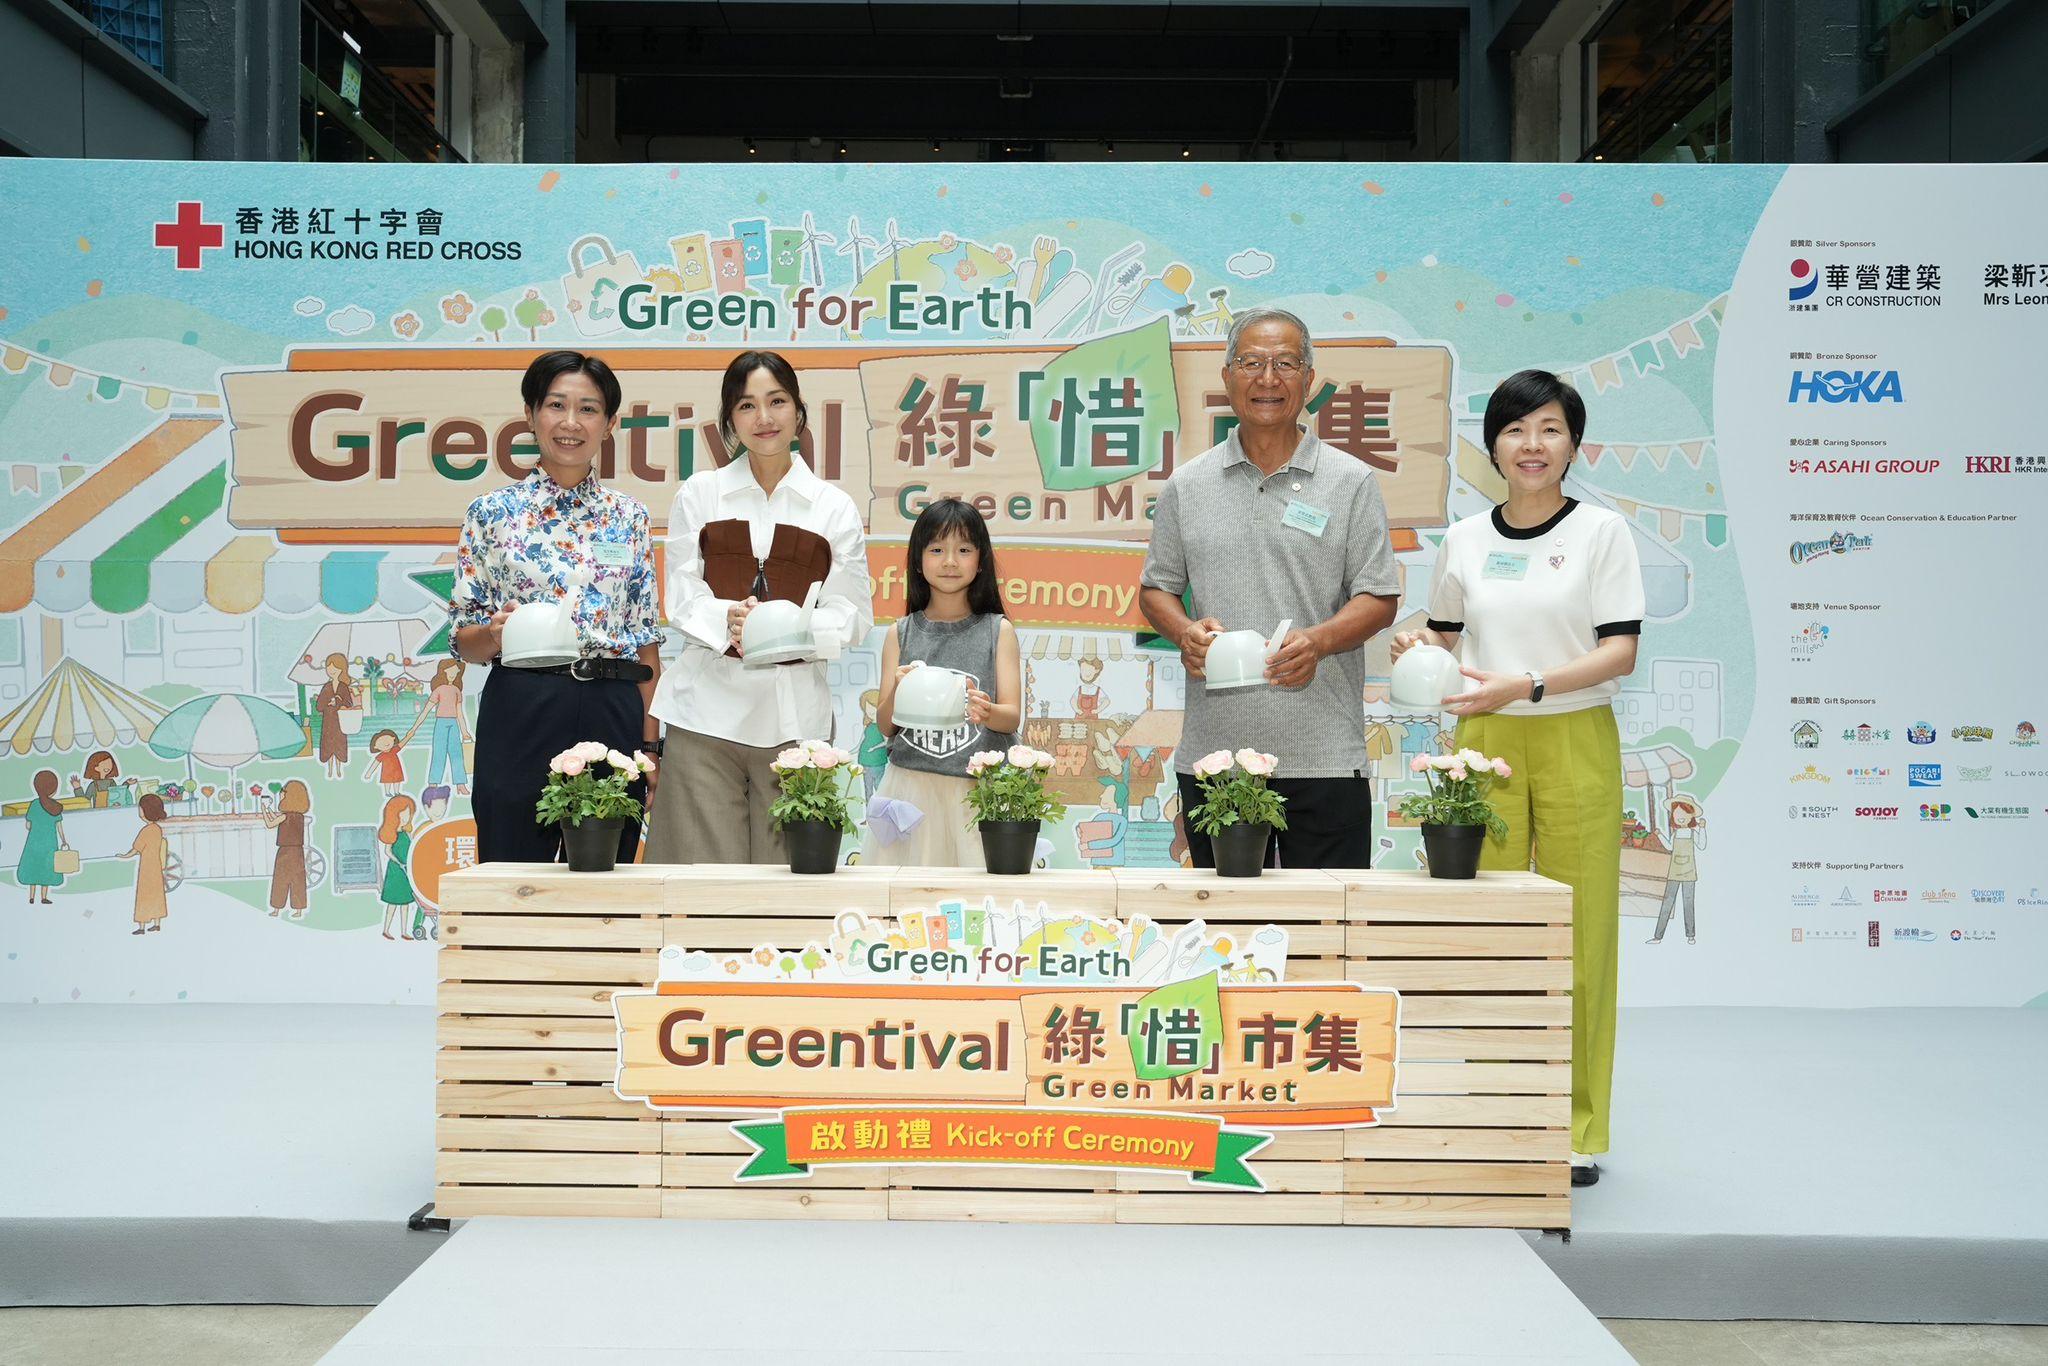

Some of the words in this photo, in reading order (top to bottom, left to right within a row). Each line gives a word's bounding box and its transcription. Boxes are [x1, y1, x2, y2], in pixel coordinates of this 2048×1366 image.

[235, 207, 444, 236] 香港紅十字會
[234, 240, 302, 259] HONG
[310, 240, 378, 260] KONG
[386, 241, 434, 260] RED
[440, 241, 522, 261] CROSS
[1839, 240, 1876, 248] Sponsors
[1825, 264, 1941, 291] 華營建築
[618, 283, 776, 331] Green
[793, 286, 873, 330] for
[888, 284, 1032, 331] Earth
[1826, 296, 1844, 306] CR
[1846, 296, 1941, 306] CONSTRUCTION
[1984, 293, 2010, 305] Mrs
[1845, 353, 1878, 361] Sponsor
[1788, 370, 1904, 403] HOKA
[1823, 439, 1848, 447] Caring
[1850, 439, 1887, 447] Sponsors
[1814, 460, 1870, 473] ASAHI
[1875, 460, 1940, 473] GROUP
[1965, 456, 2012, 473] HKRI
[897, 484, 1067, 520] Geen
[1849, 603, 1881, 611] Sponsor
[1790, 645, 1814, 653] mills
[1840, 698, 1876, 706] Sponsors
[1855, 807, 1899, 816] SOYJOY
[867, 942, 967, 977] Green
[979, 944, 1029, 977] for
[1038, 943, 1131, 978] Earth
[658, 1007, 1009, 1074] Greentival
[1043, 1074, 1150, 1101] Green
[1169, 1076, 1298, 1103] Market
[811, 1119, 932, 1152] 啟動禮
[946, 1122, 1056, 1149] Kick-off
[1062, 1124, 1195, 1158] Ceremony
